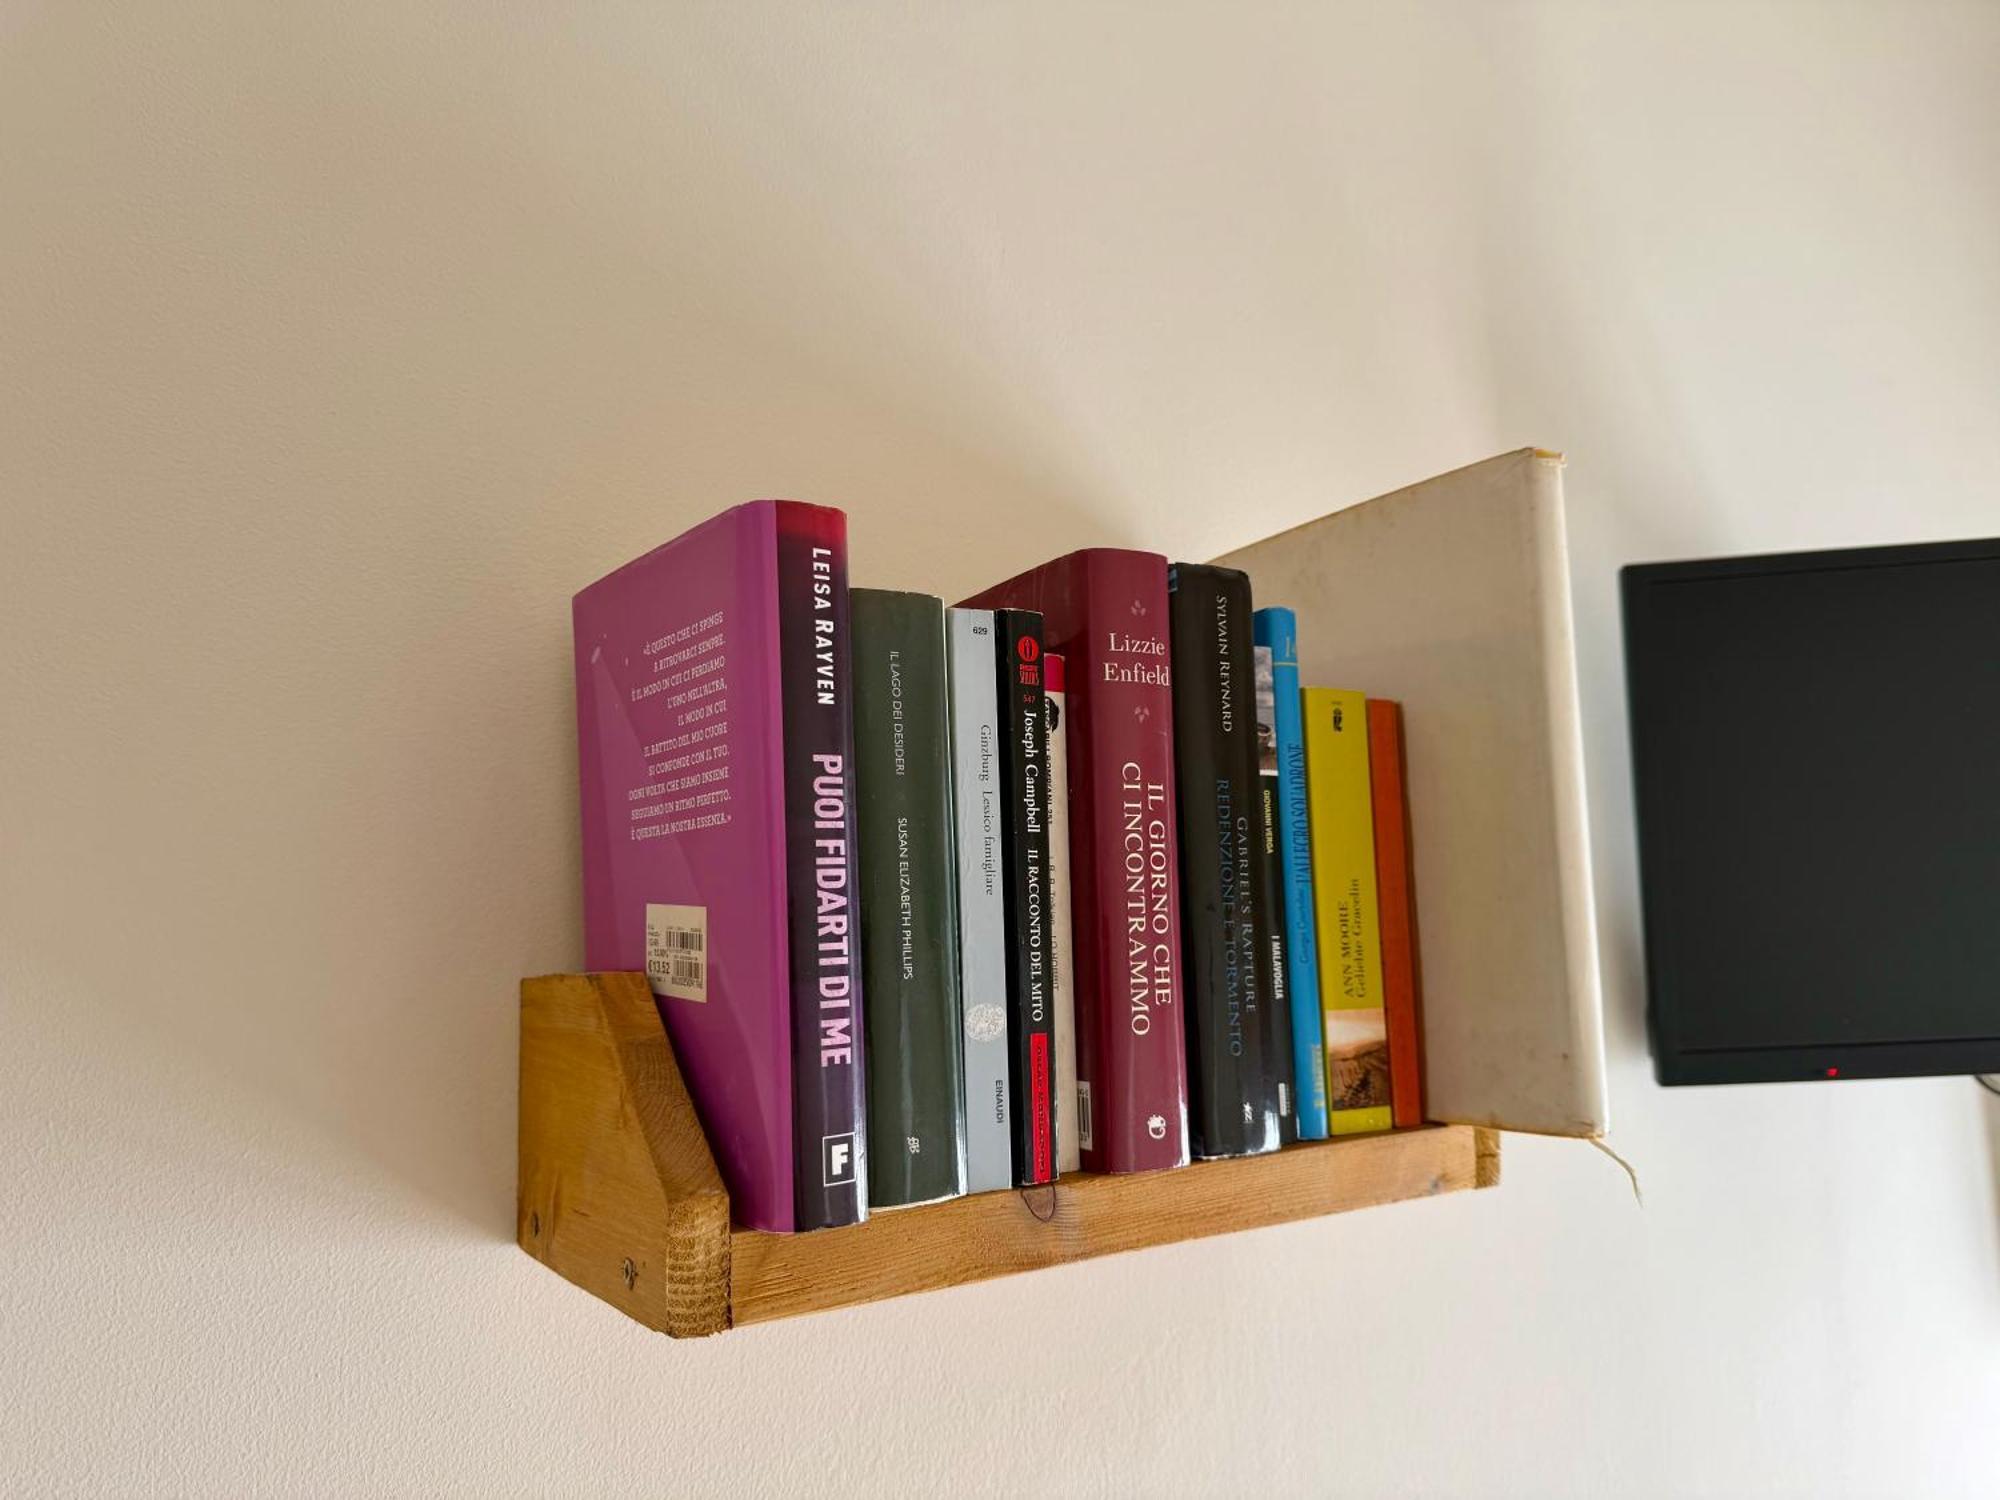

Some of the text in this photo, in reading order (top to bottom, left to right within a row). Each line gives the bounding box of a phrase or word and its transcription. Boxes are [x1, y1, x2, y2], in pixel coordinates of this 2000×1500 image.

[651, 634, 676, 653] QUESTO
[676, 627, 691, 642] CHE
[692, 623, 698, 635] CI
[812, 547, 835, 705] LEISA RAYVEN
[973, 626, 988, 635] 629
[1108, 633, 1165, 656] Lizzie
[643, 680, 662, 697] MODO
[683, 670, 690, 682] CI
[691, 656, 724, 679] PERDIAMO
[1103, 662, 1170, 687] Enfield
[1216, 594, 1233, 733] SYLVAIN REYNARD
[651, 738, 678, 755] BATTITO
[678, 734, 690, 747] DEL
[692, 730, 704, 744] MIO
[705, 722, 727, 738] CUORE
[685, 707, 705, 723] MODO
[705, 704, 713, 716] IN
[714, 699, 726, 713] CUI
[890, 651, 904, 775] IL LAGO DEI DESIDERI
[645, 782, 666, 796] VOLTA
[666, 779, 679, 792] CHE
[681, 774, 700, 789] SIAMO
[702, 766, 728, 783] INSIEME
[656, 755, 690, 774] CONFONDE
[691, 751, 705, 764] CON
[1022, 710, 1041, 833] Joseph Campbell
[636, 825, 661, 840] QUESTA
[671, 818, 696, 832] NOSTRA
[675, 796, 695, 811] RITMO
[979, 724, 993, 896] Ginzburg Lessico famigliare
[1264, 790, 1274, 855] GIOVANNI VERGA
[812, 754, 852, 1068] PUOI FIDARTI DI ME
[898, 818, 913, 980] SUSAN ELIZABETH PHILLIPS
[1122, 762, 1151, 1036] CI INCONTRAMMO
[1147, 782, 1172, 1006] IL GIORNO CHE
[1216, 778, 1242, 1057] REDENZIONE E TORMENTO
[1236, 815, 1256, 1013] GABRIEL'S RAPTURE
[1027, 849, 1043, 1023] IL RACCONTO DEL MITO
[1338, 901, 1354, 997] ANN MOORE
[1271, 942, 1285, 1000] MALAVOGLIA
[995, 1079, 1004, 1124] EINAUDI
